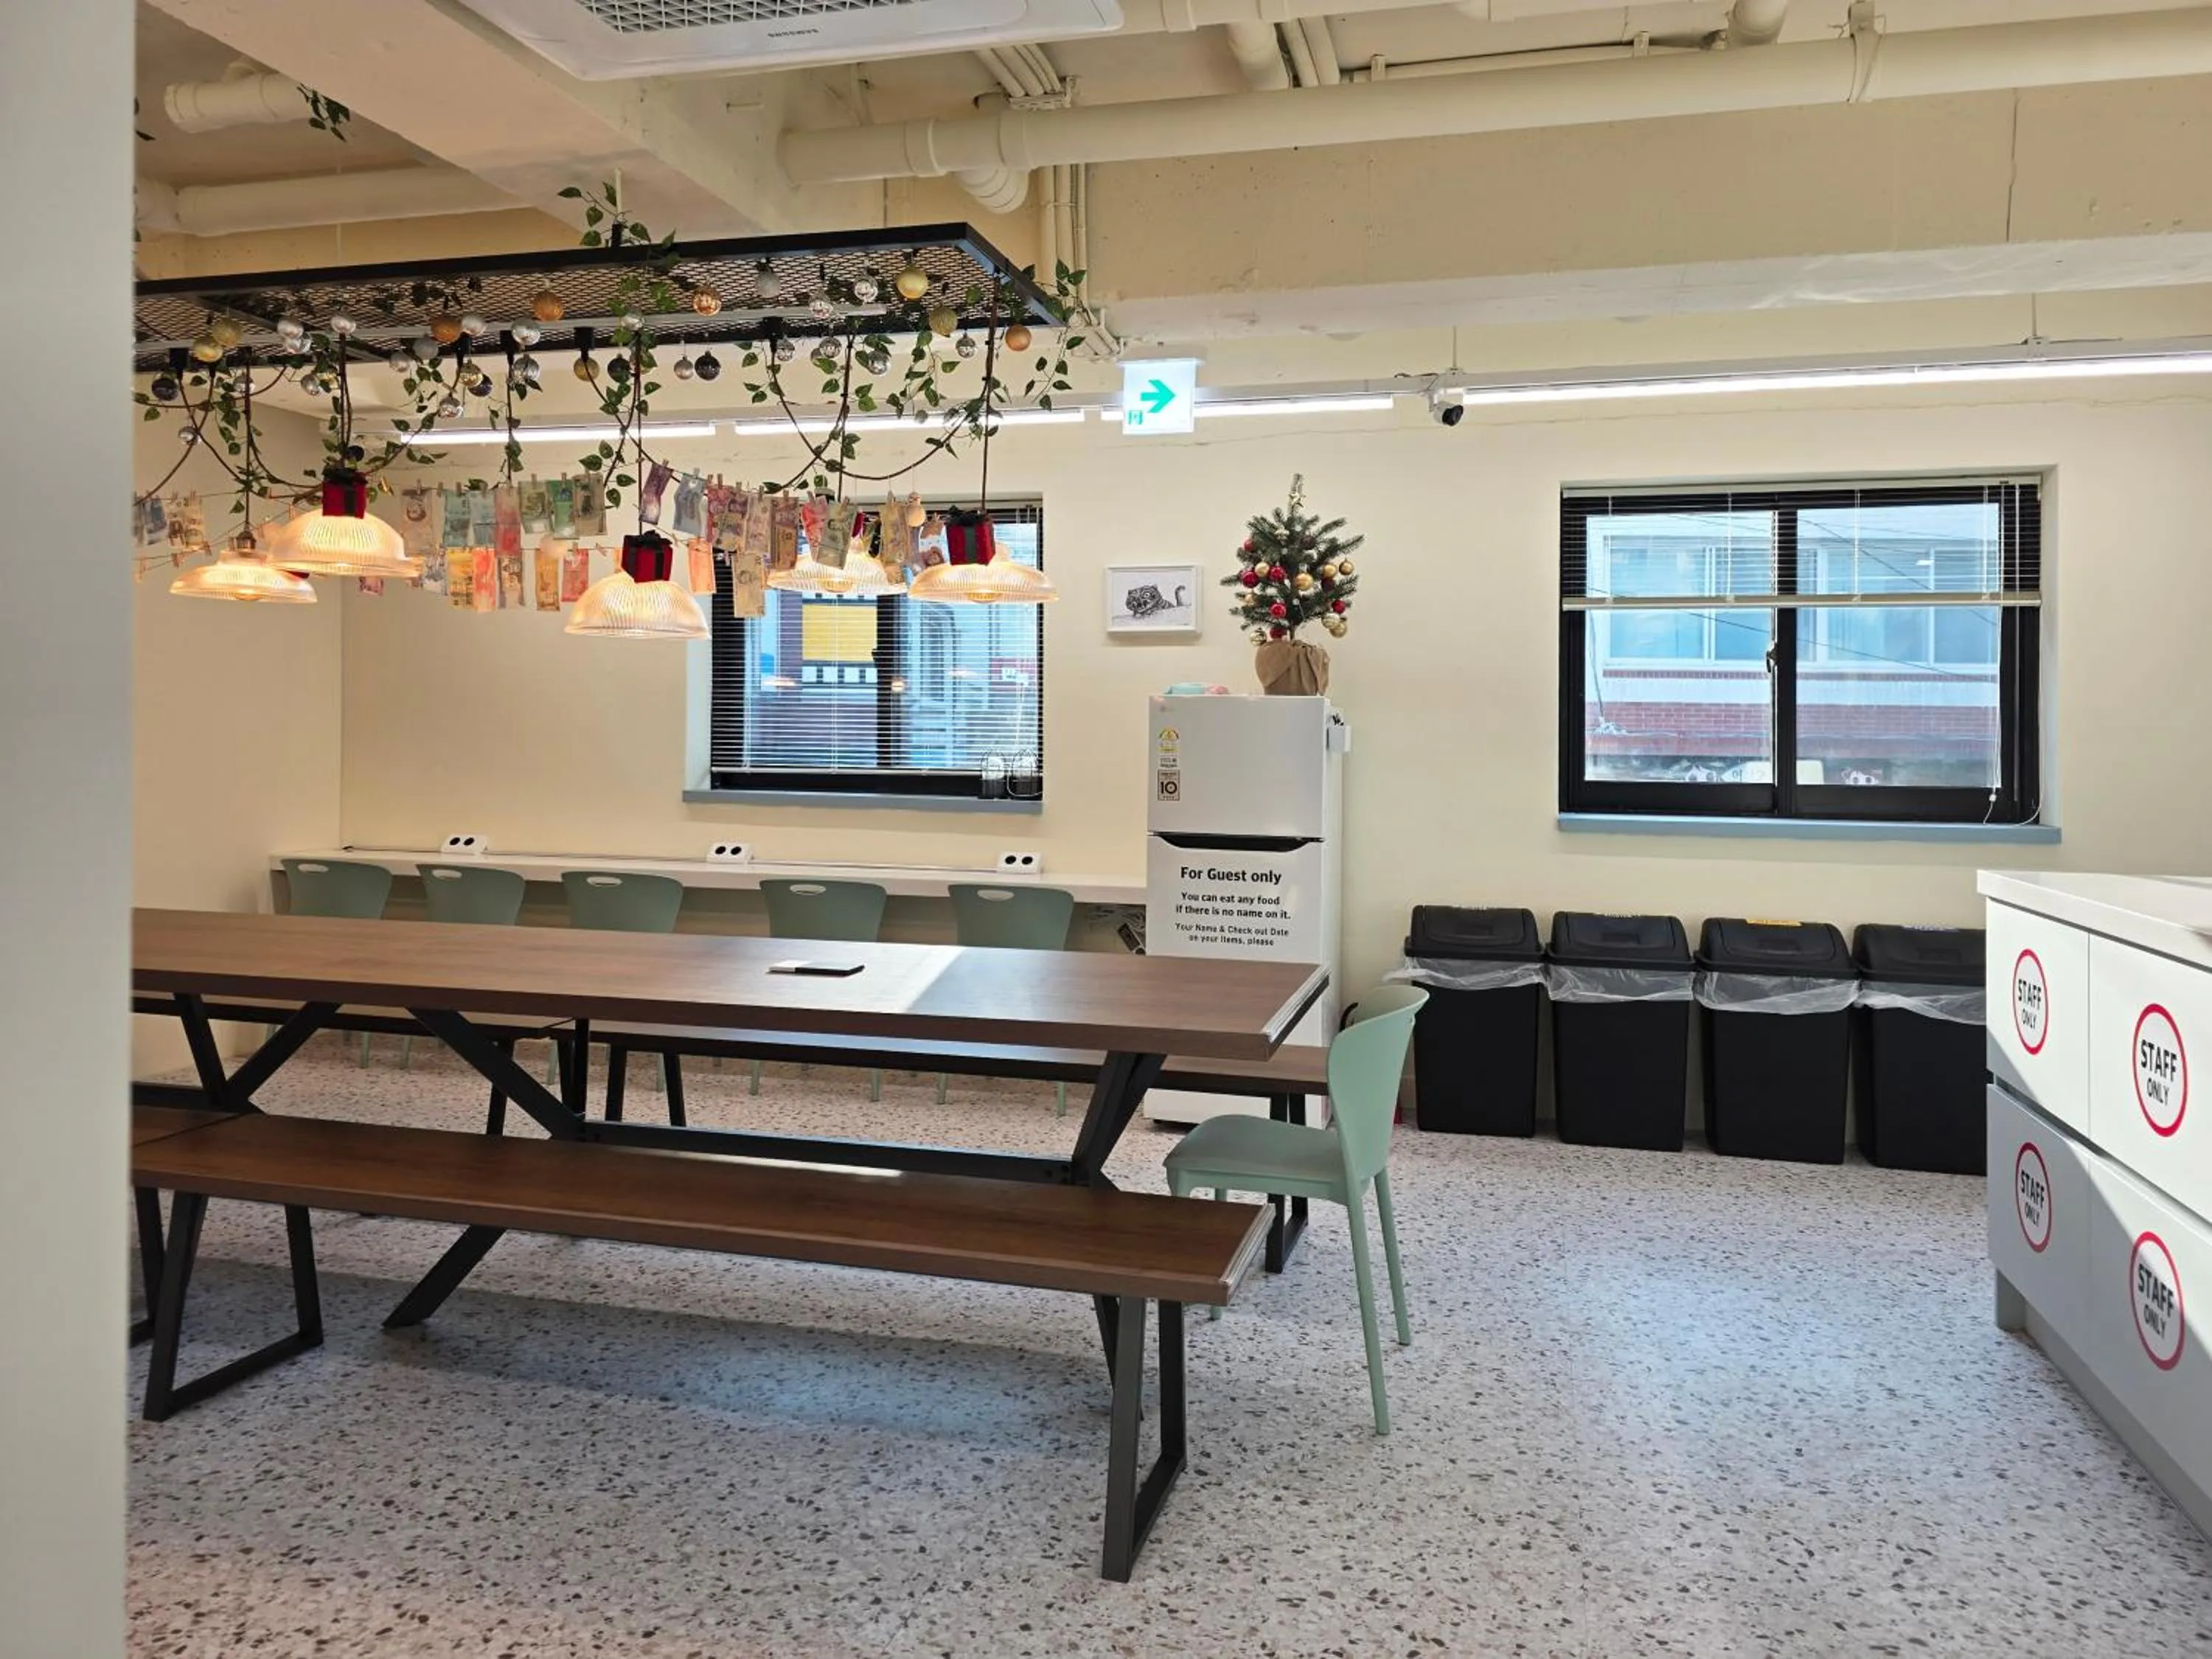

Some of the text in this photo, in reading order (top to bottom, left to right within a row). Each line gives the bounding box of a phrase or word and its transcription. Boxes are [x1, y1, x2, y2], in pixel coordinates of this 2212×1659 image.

[1180, 866, 1282, 886] For Guest only
[1181, 891, 1281, 905] You can eat any food
[1185, 905, 1210, 915] there
[1211, 906, 1220, 915] is
[1237, 909, 1263, 918] name
[1280, 910, 1291, 919] it.
[1175, 922, 1193, 931] Your
[1195, 923, 1217, 933] Name
[1228, 925, 1252, 934] Check
[1254, 928, 1267, 936] out
[1270, 928, 1289, 936] Date
[1200, 935, 1218, 943] your
[1247, 937, 1275, 946] please
[2018, 978, 2041, 1010] STAFF
[2022, 1008, 2037, 1029] ONLY
[2140, 1039, 2177, 1082] STAFF
[2146, 1077, 2169, 1105] ONLY
[2021, 1169, 2045, 1209] STAFF
[2025, 1202, 2039, 1227] ONLY
[2138, 1263, 2174, 1318] STAFF
[2143, 1304, 2166, 1340] ONLY
